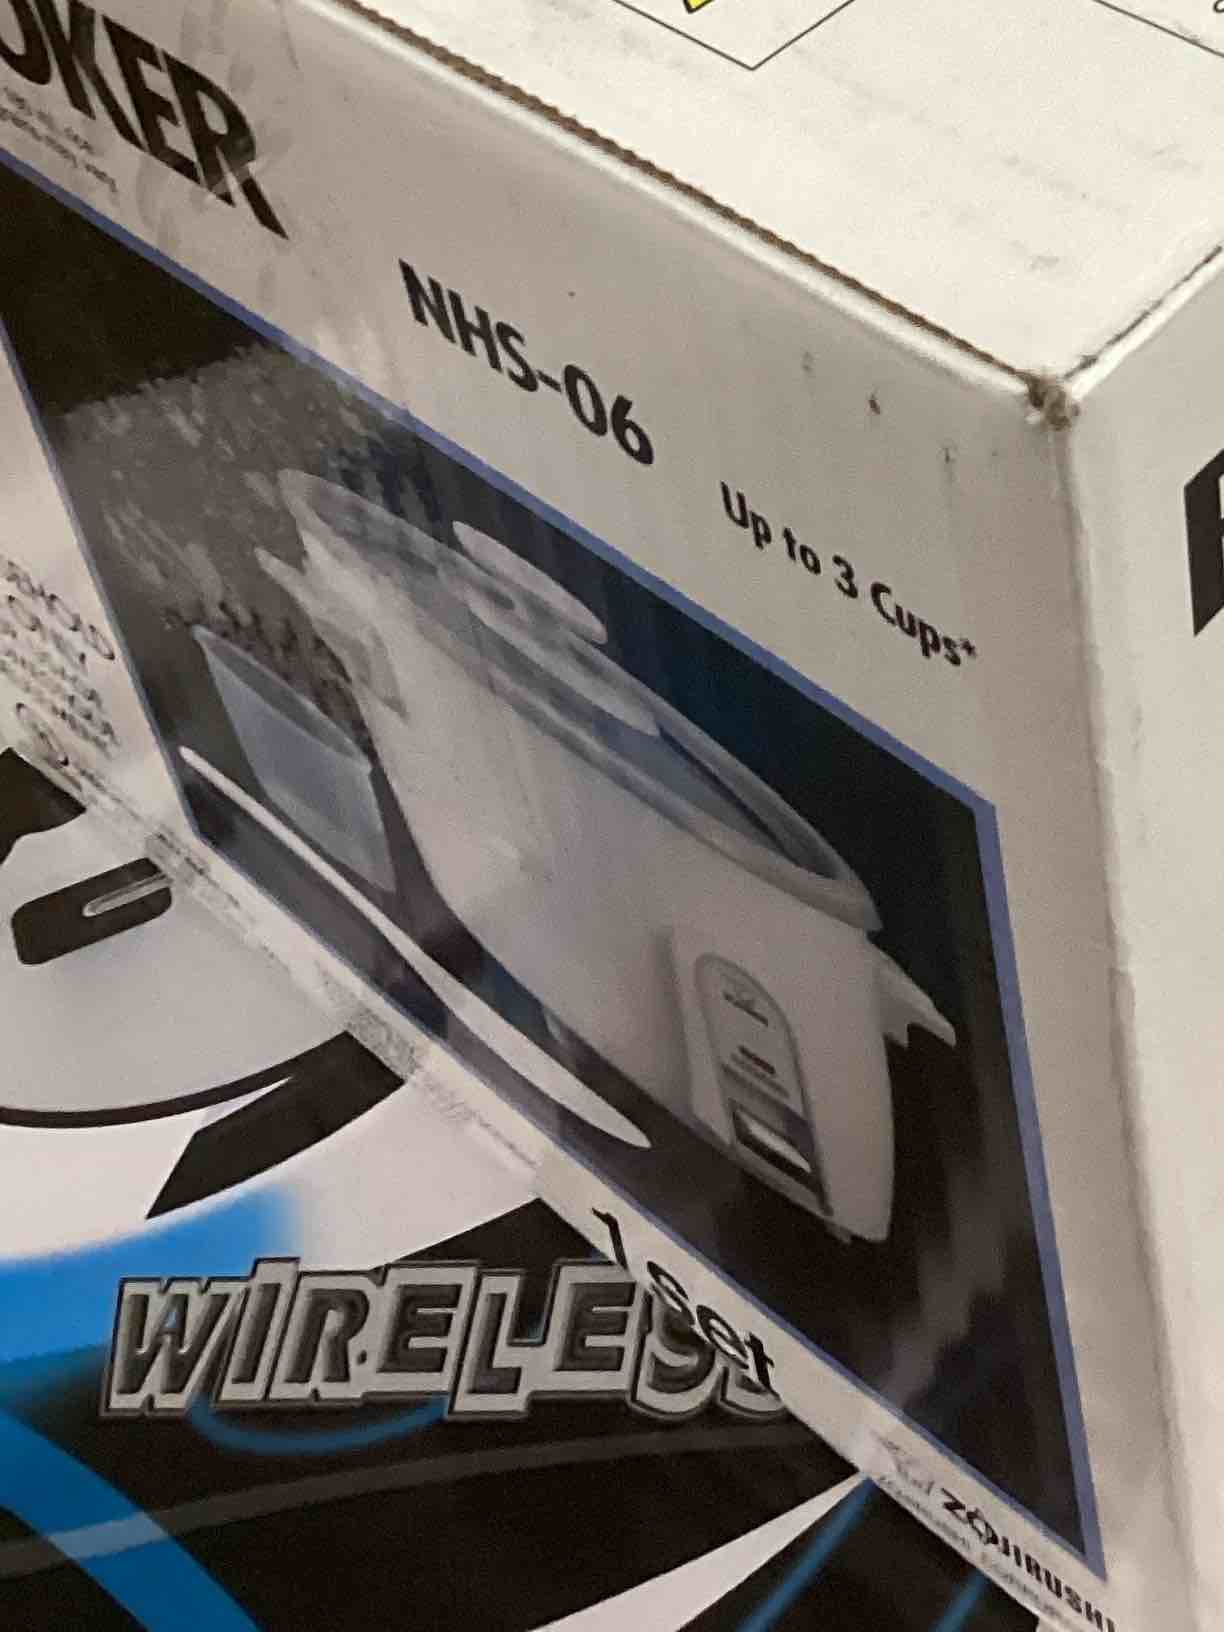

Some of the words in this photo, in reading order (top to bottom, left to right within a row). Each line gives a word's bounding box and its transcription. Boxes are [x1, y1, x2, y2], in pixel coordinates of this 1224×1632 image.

[398, 257, 655, 466] NHS-06
[720, 480, 773, 551] Up
[783, 526, 821, 577] to
[832, 554, 859, 600] 3
